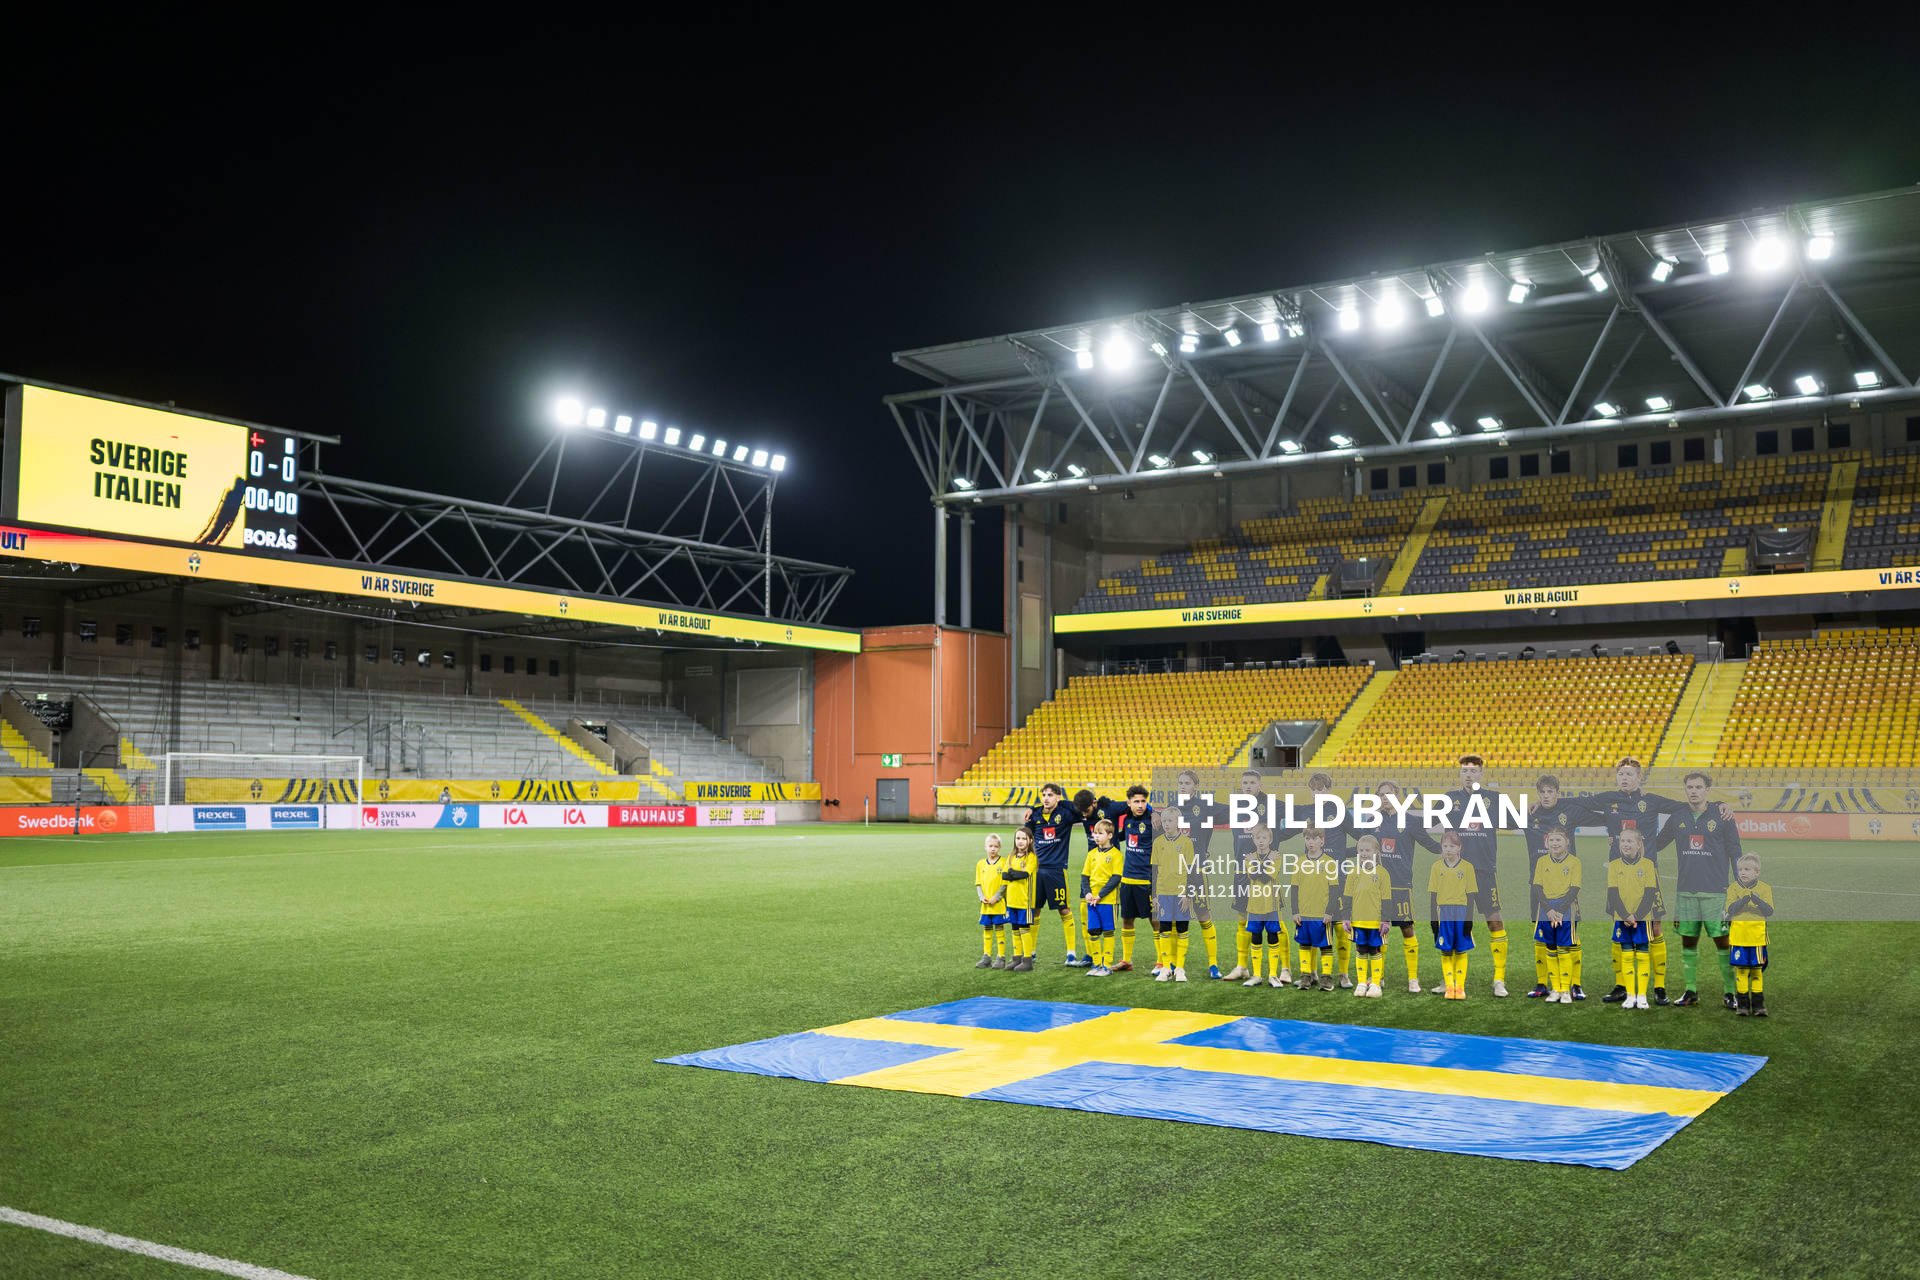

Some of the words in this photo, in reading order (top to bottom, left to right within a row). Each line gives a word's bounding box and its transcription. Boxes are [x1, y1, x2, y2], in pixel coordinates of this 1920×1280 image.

[90, 438, 187, 478] SVERIGE
[94, 472, 181, 508] ITALIEN
[243, 528, 297, 550] BORÅS
[1879, 572, 1892, 584] VI
[1895, 570, 1912, 584] ÄR
[361, 575, 372, 590] VI
[374, 576, 389, 592] ÄR
[391, 579, 435, 597] SVERIGE
[1504, 593, 1515, 604] VI
[658, 612, 667, 625] VI
[1182, 611, 1191, 622] VI
[1206, 608, 1242, 620] SVERIGE
[697, 784, 706, 797] VI
[719, 785, 751, 797] SVERIGE
[18, 814, 95, 829] Swedbank
[381, 810, 416, 818] SVENSKA
[504, 808, 528, 825] ICA
[563, 808, 586, 825] ICA
[621, 808, 685, 823] BAUHAUS
[1054, 888, 1066, 901] 19
[1396, 902, 1410, 917] 10
